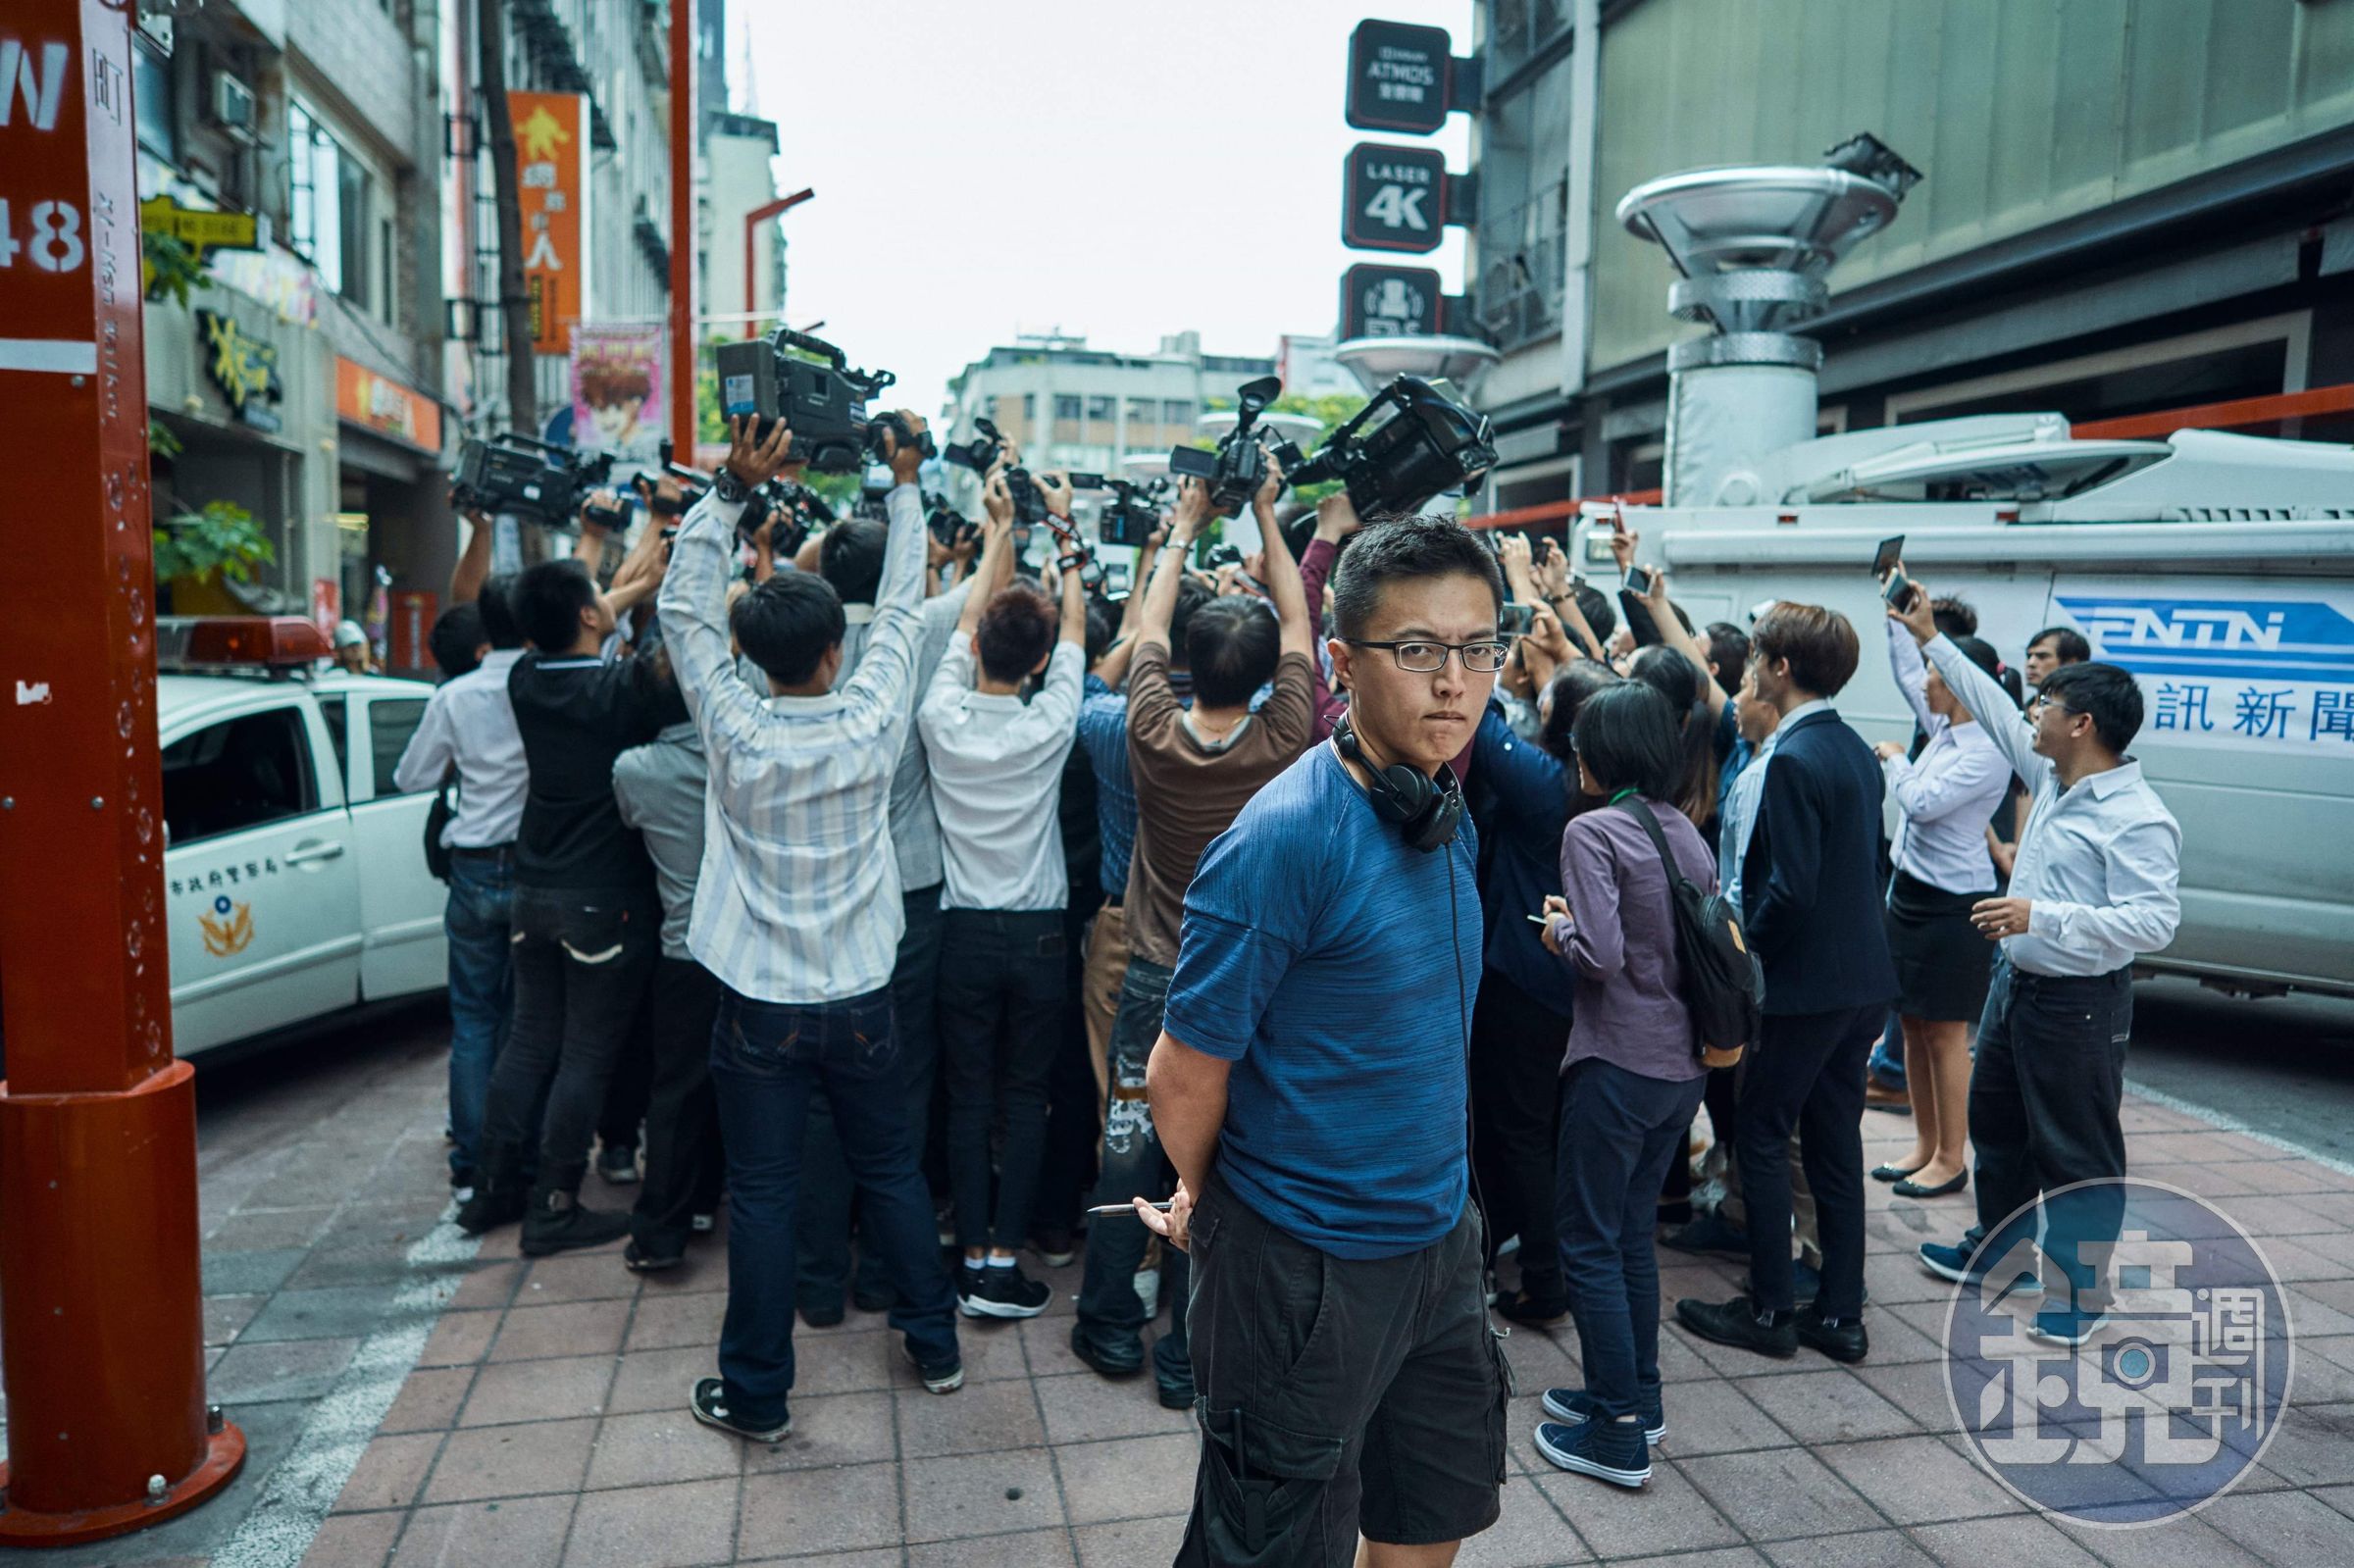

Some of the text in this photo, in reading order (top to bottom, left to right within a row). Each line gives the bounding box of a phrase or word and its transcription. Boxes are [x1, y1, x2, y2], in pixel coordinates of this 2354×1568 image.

[1367, 60, 1435, 85] ATMOS
[1366, 162, 1431, 185] LASER
[1364, 184, 1428, 231] 4K
[2154, 683, 2354, 741] 訊新聞
